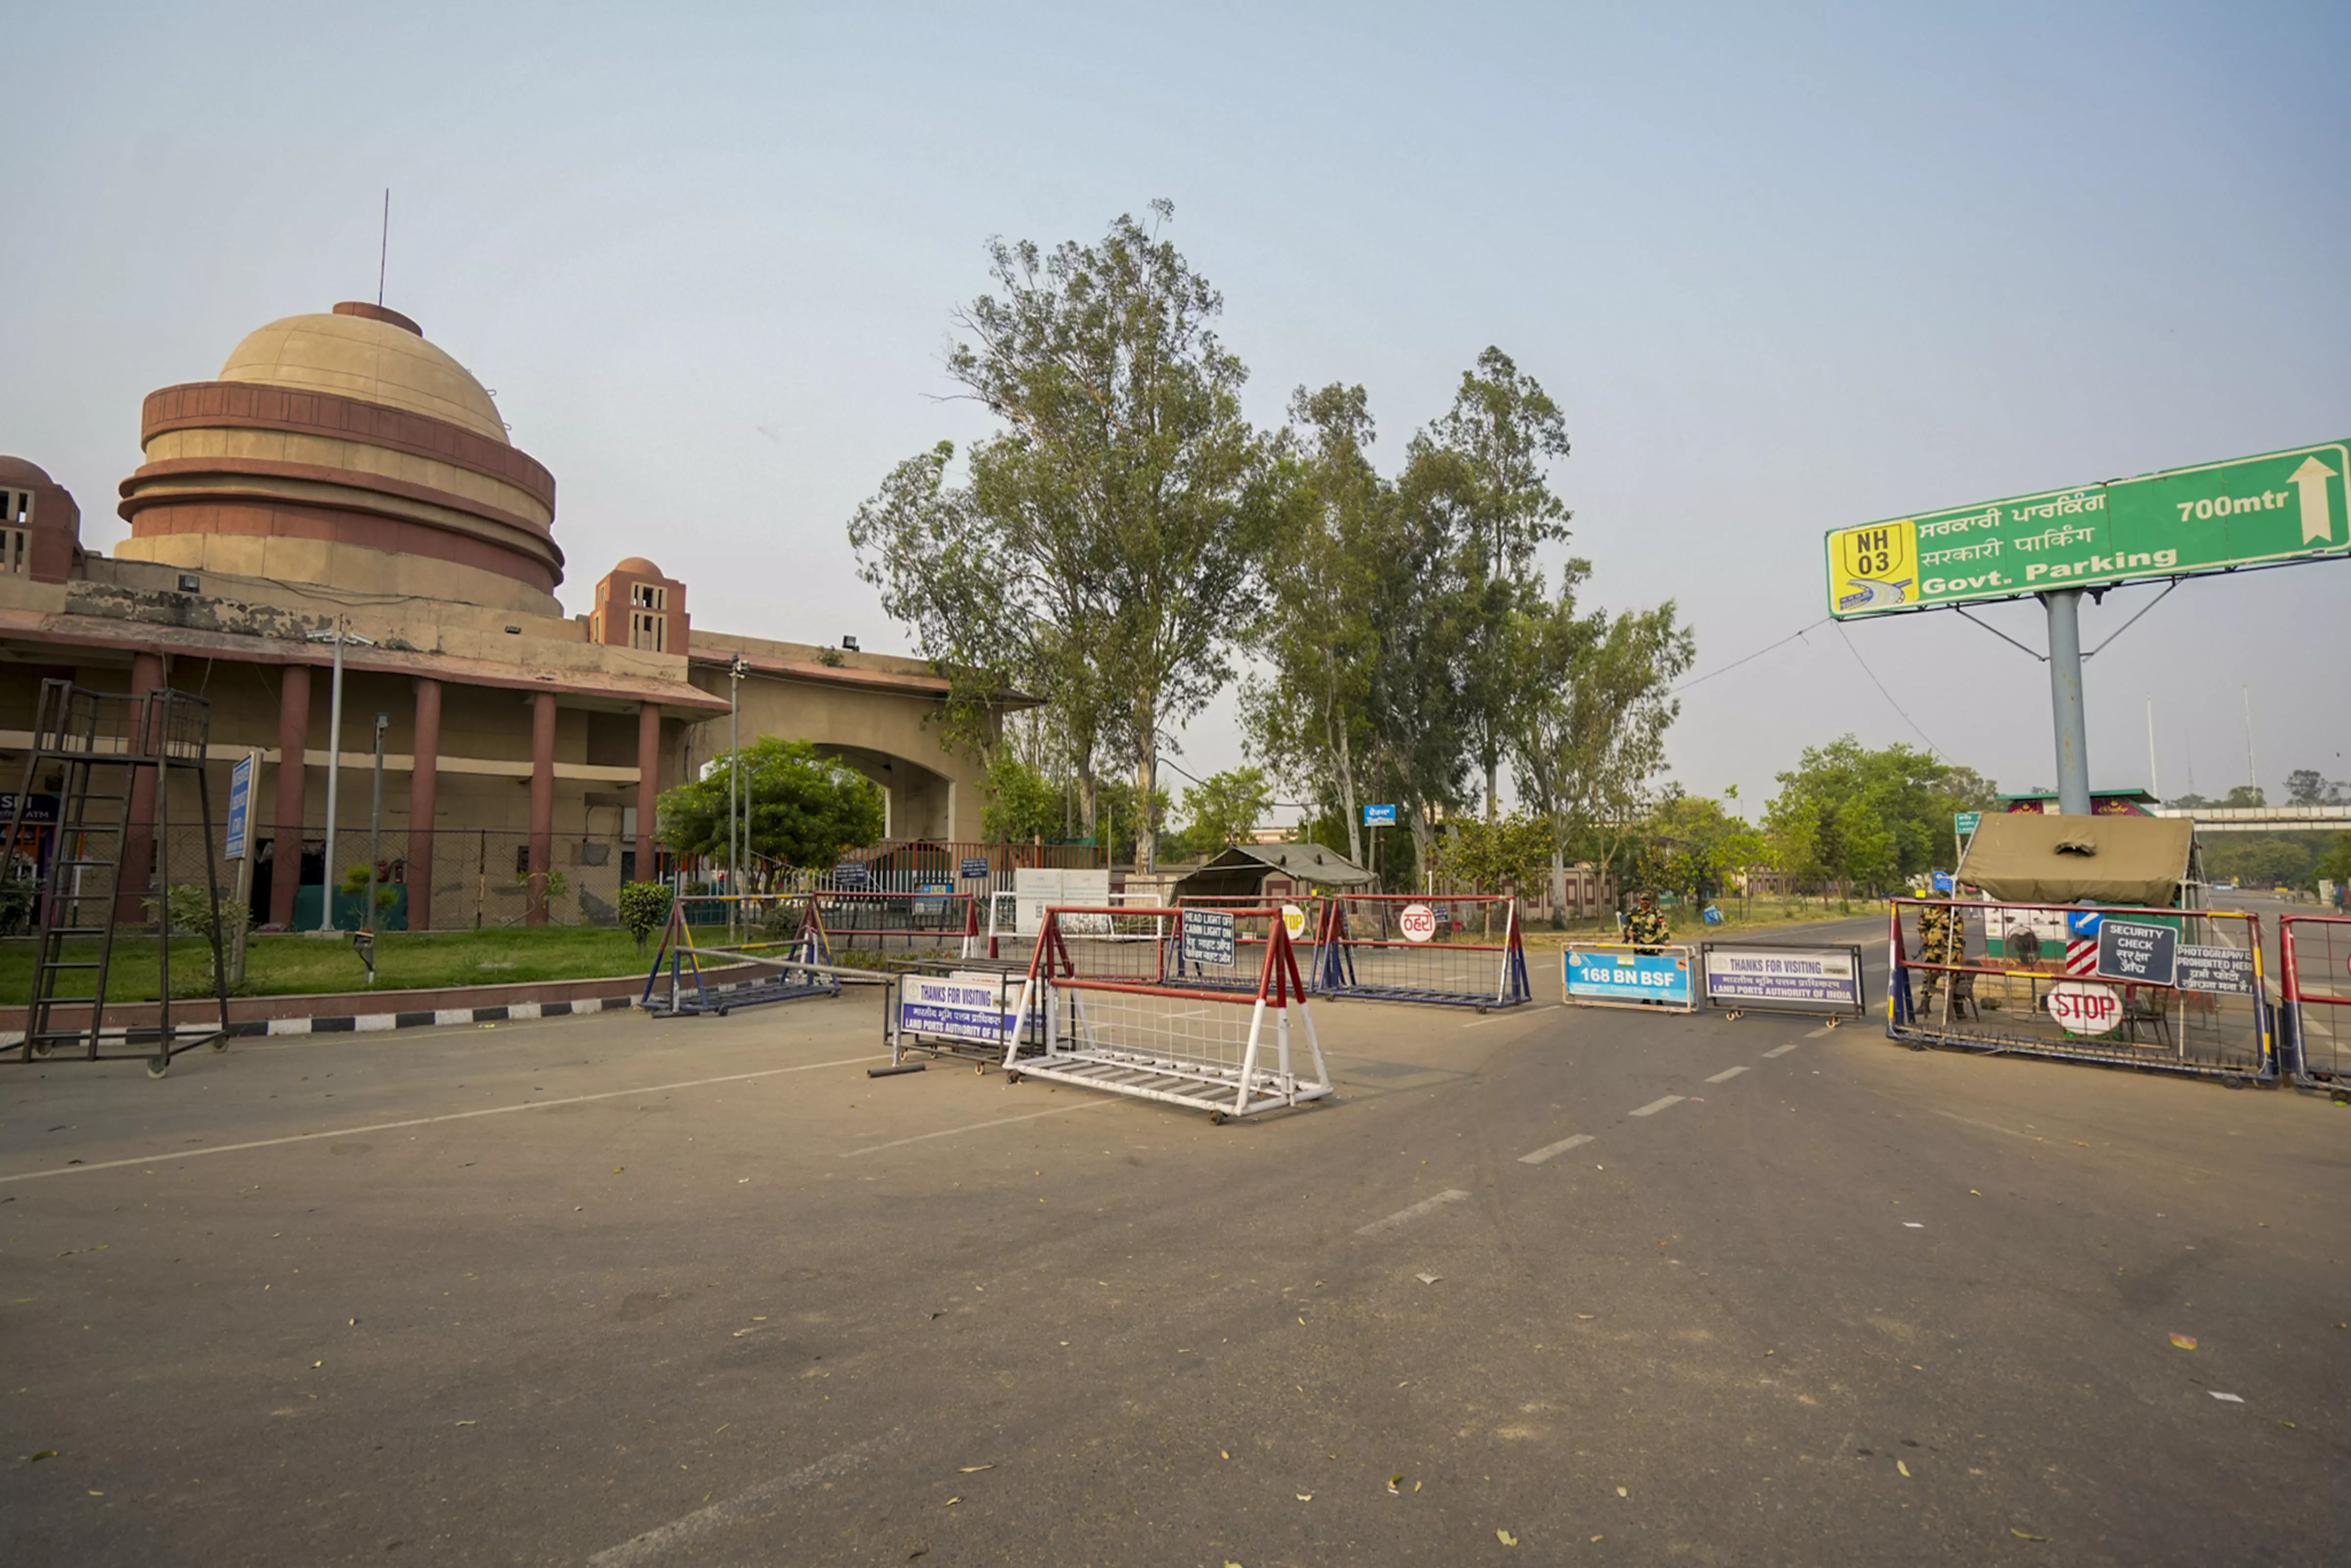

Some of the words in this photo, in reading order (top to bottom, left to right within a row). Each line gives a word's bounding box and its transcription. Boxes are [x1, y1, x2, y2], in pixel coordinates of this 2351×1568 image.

[1919, 507, 2002, 538] ਸਰਕਾਰੀ
[2012, 493, 2106, 522] ਪਾਰਕਿੰਗ
[2177, 490, 2289, 522] 700mtr
[1857, 529, 1888, 553] NH
[1920, 538, 2004, 567] सरकारी
[2014, 524, 2096, 551] पार्किंग
[1858, 551, 1889, 575] 03
[1921, 570, 2013, 594] Govt.
[2026, 548, 2177, 581] Parking
[1203, 914, 1221, 925] LIGHT
[1283, 914, 1303, 930] TOP
[1404, 910, 1433, 931] ठहरो
[1203, 926, 1221, 936] LIGHT
[1223, 928, 1231, 938] ON
[2110, 925, 2164, 939] SECURITY
[2117, 937, 2154, 950] CHECK
[2178, 947, 2243, 960] PHOTOGRAPHY
[1730, 958, 1763, 972] THANKS
[1766, 961, 1782, 973] FOR
[1784, 962, 1822, 974] VISITING
[2177, 956, 2231, 970] PROHIBITED
[1581, 967, 1610, 983] 168
[1613, 969, 1637, 984] BN
[1641, 971, 1674, 987] BSF
[921, 985, 946, 1002] THANKS
[947, 987, 960, 1004] FOR
[962, 988, 991, 1007] VISITING
[1714, 984, 1735, 994] LAND
[1737, 986, 1763, 995] PORTS
[1765, 988, 1811, 998] AUTHORITY
[1826, 991, 1852, 1000] INDIA
[2054, 992, 2115, 1020] STOP
[906, 1018, 922, 1028] LAND
[923, 1020, 944, 1032] PORTS
[945, 1022, 981, 1037] AUTHORITY
[983, 1027, 991, 1038] OF
[993, 1028, 1013, 1040] INIA
